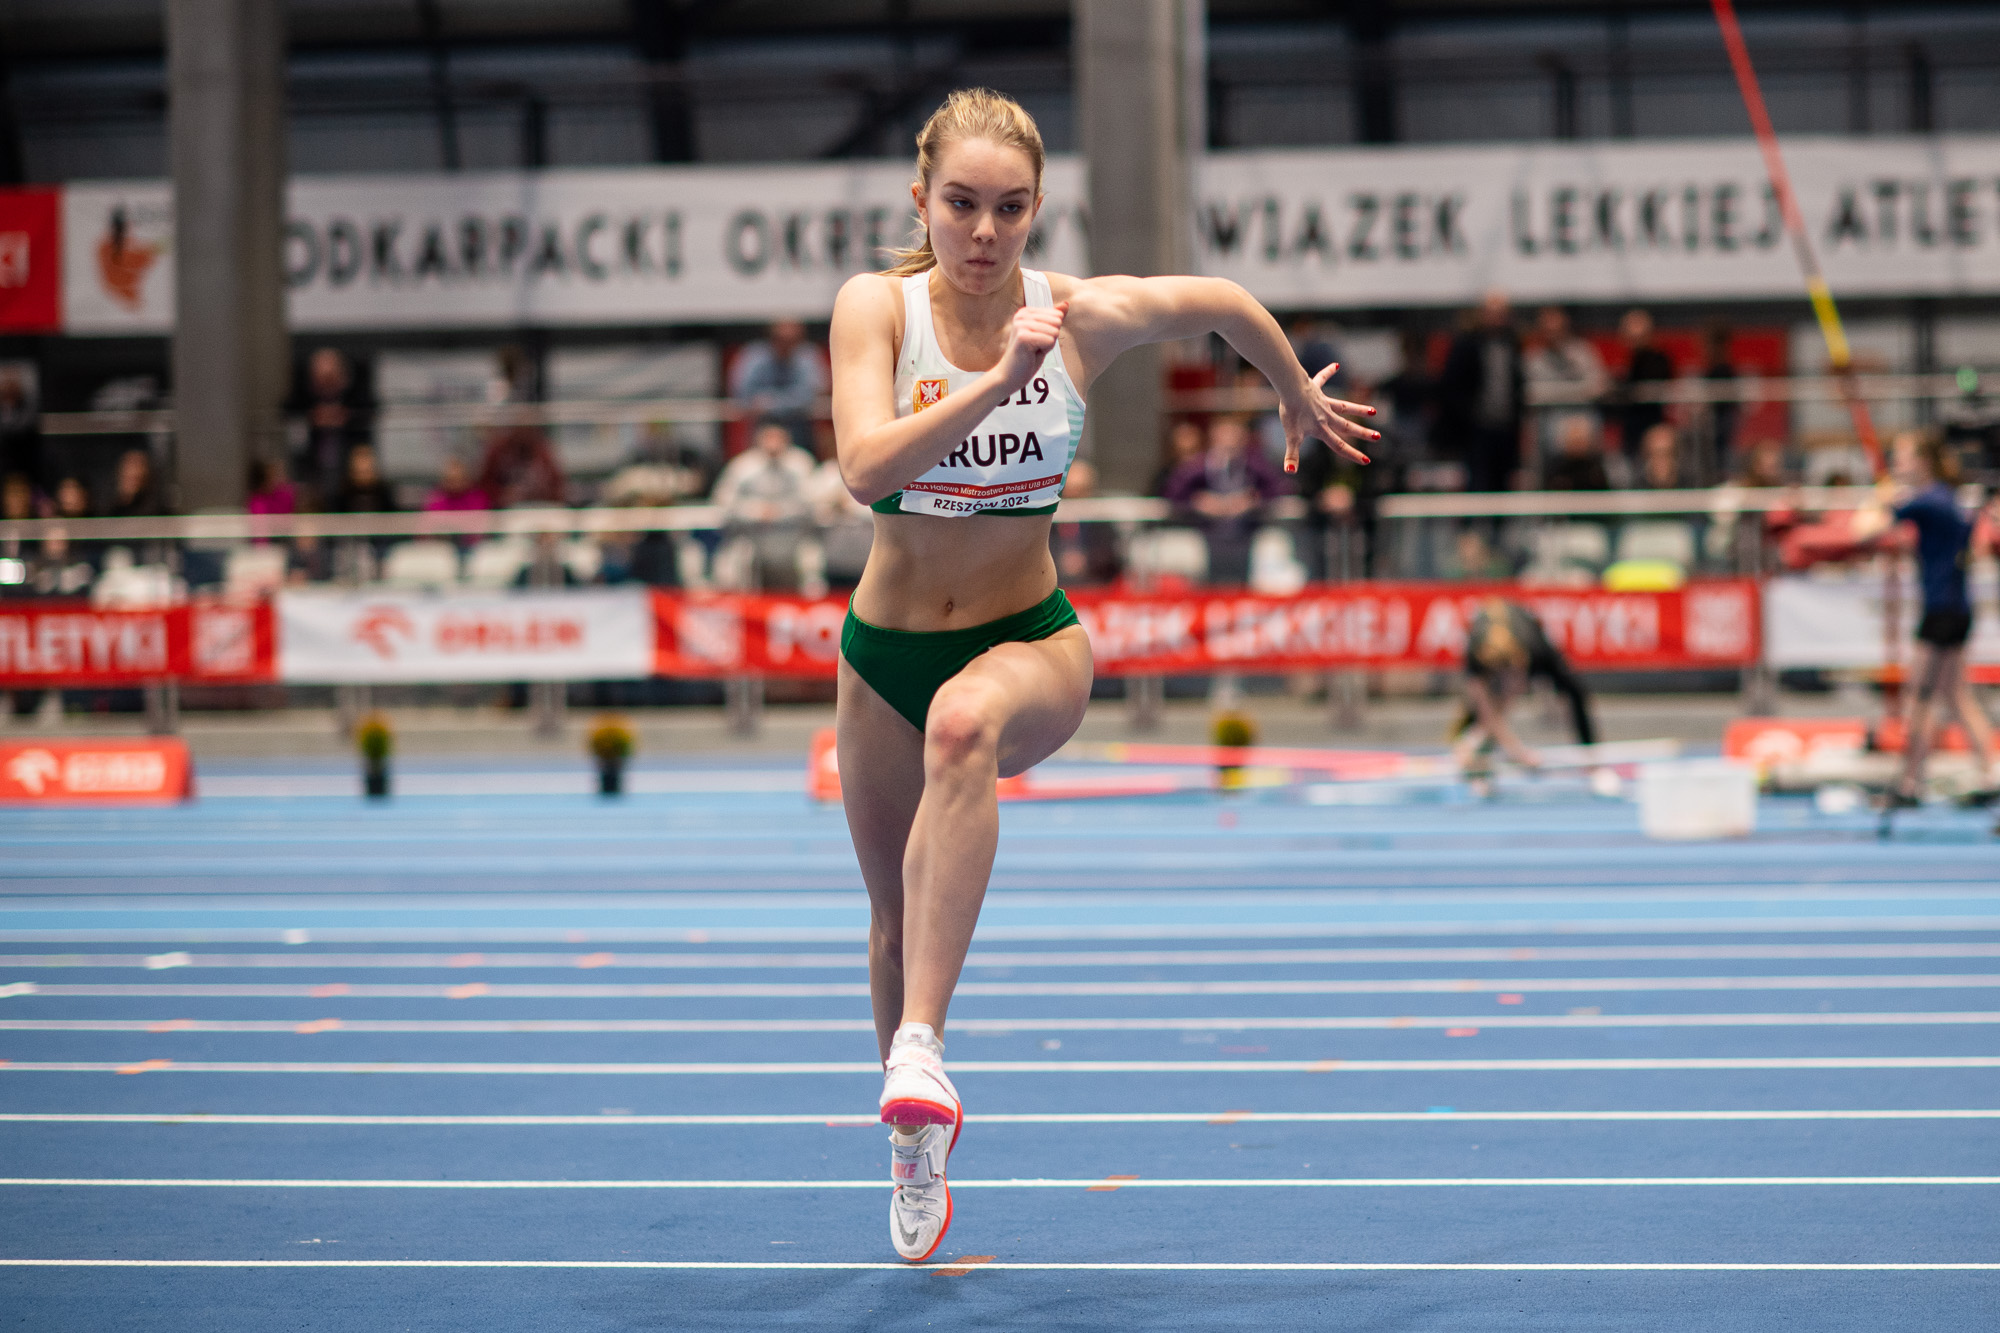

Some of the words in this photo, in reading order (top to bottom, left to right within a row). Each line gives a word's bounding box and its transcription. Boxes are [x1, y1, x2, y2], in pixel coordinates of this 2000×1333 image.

[286, 209, 684, 288] ODKARPACKI
[1206, 190, 1467, 266] WIĄZEK
[996, 377, 1050, 407] 19
[939, 431, 1044, 468] RUPA
[930, 484, 960, 494] Halowe
[960, 487, 1004, 497] Mistrzostwa
[1005, 483, 1028, 492] Polski
[1028, 480, 1041, 490] U18
[1042, 477, 1056, 486] U20
[933, 498, 999, 512] RZESZÓW
